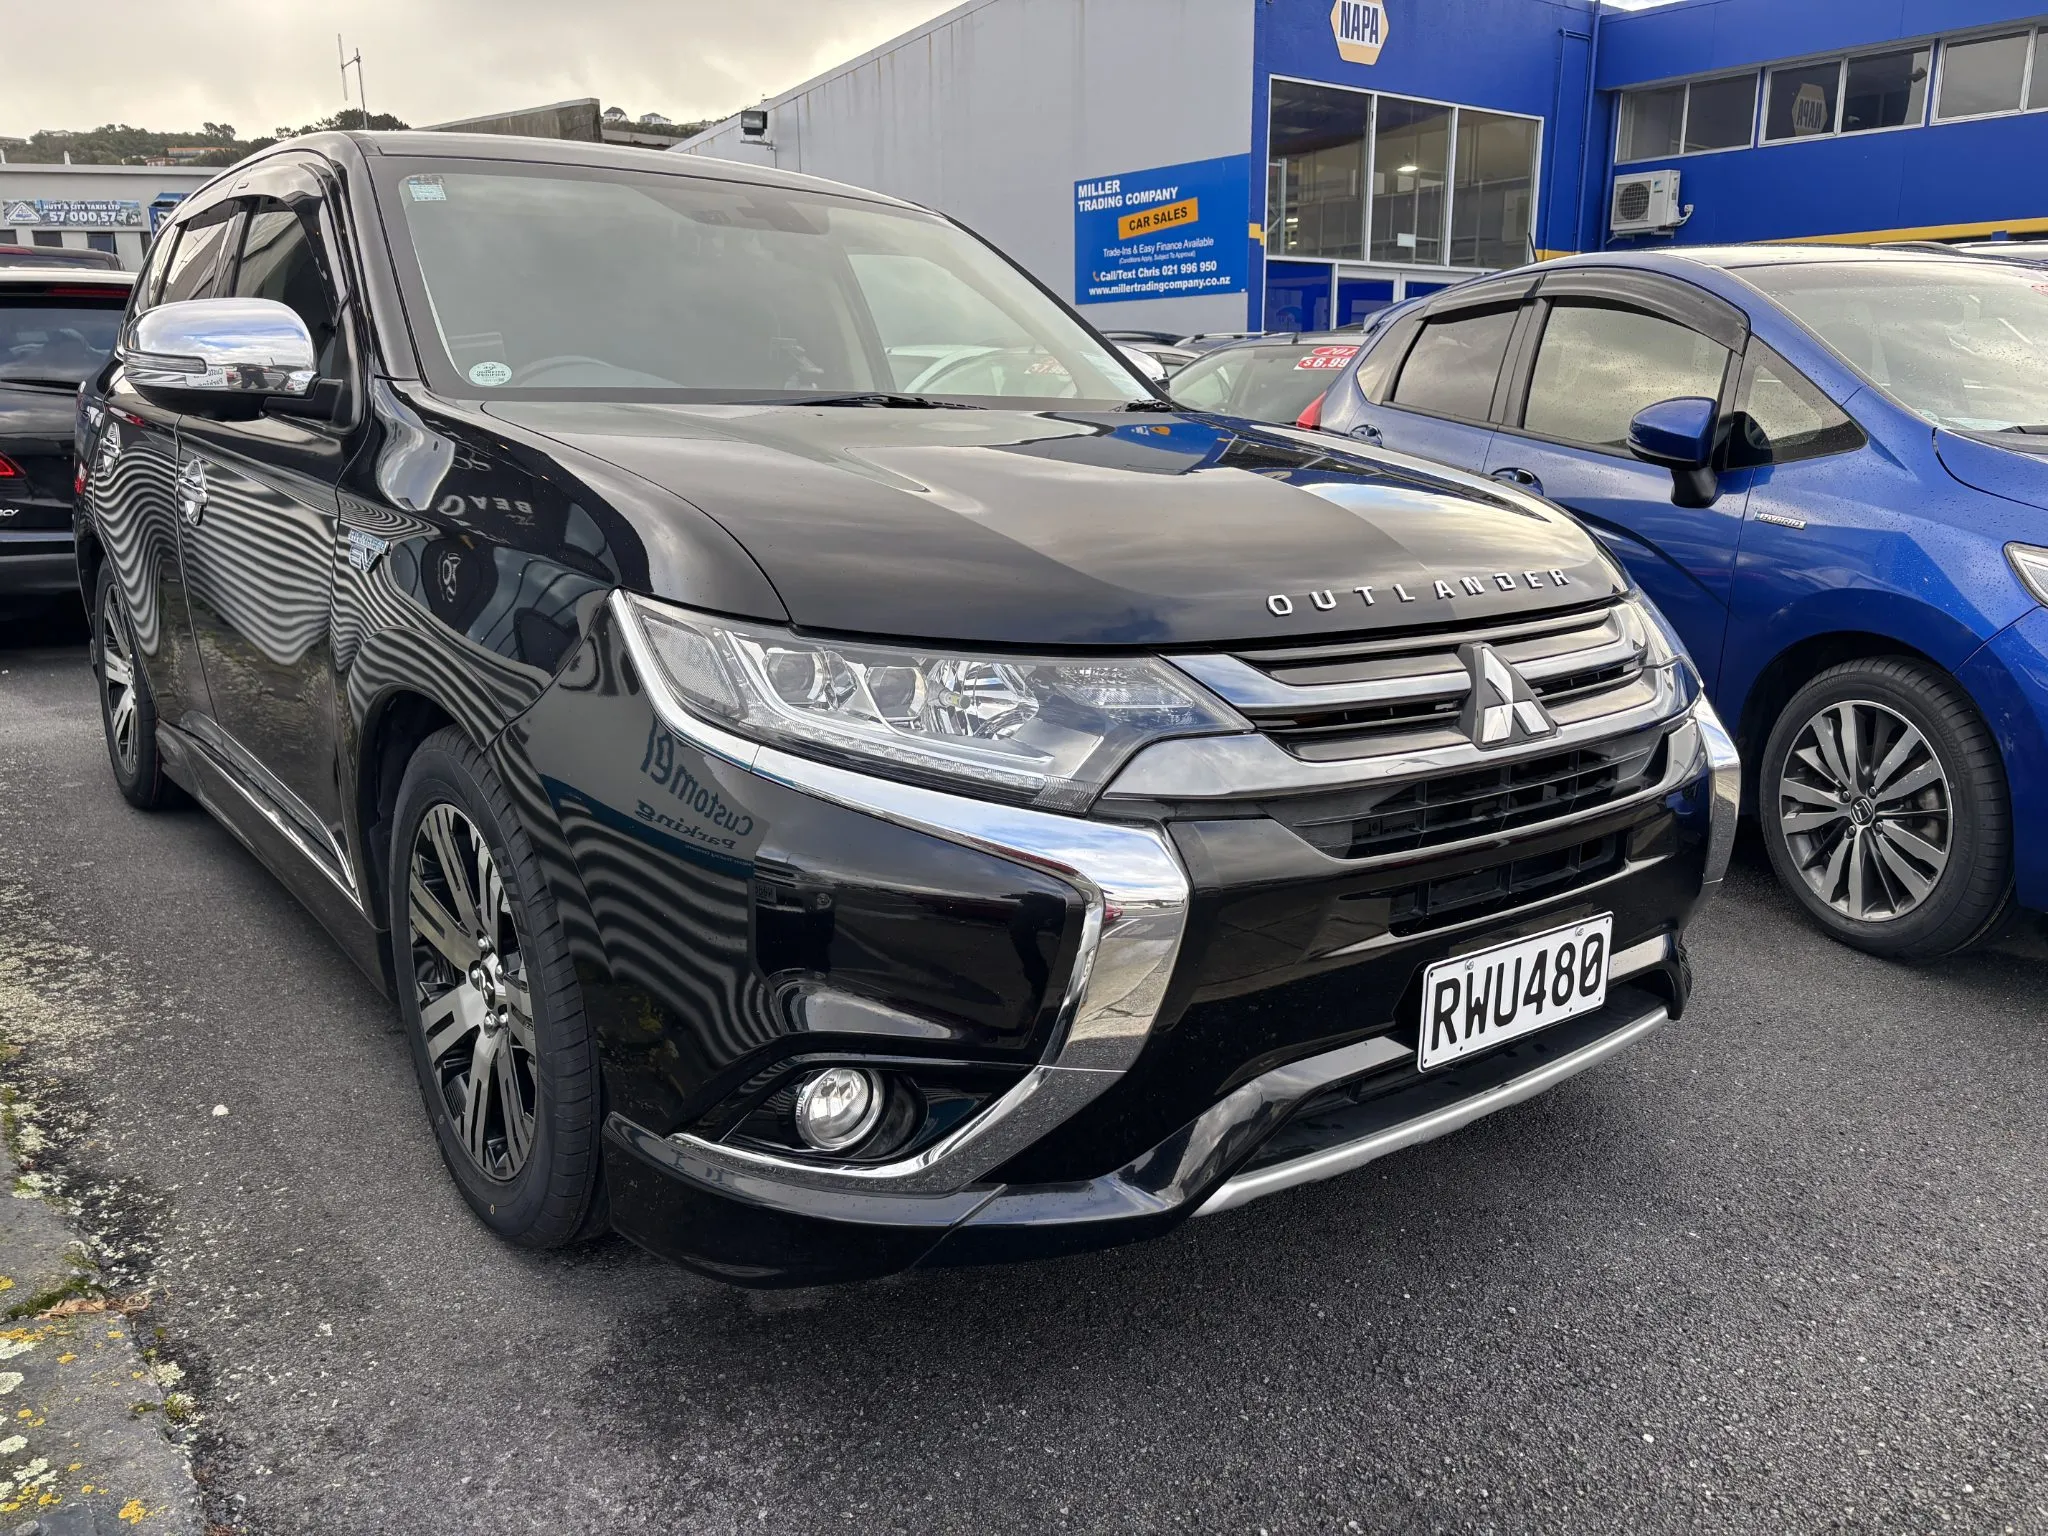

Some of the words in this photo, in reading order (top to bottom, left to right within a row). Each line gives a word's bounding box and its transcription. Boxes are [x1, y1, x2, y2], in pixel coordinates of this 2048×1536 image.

[1340, 1, 1379, 44] NAPA
[1078, 179, 1121, 198] MILLER
[1078, 196, 1123, 212] TRADING
[1125, 186, 1179, 205] COMPANY
[1129, 215, 1150, 231] CAR
[1153, 206, 1188, 226] SALES
[1103, 247, 1132, 258] Trade-Ins
[1132, 245, 1139, 254] &
[1139, 243, 1155, 254] Easy
[1156, 241, 1182, 252] Finance
[1183, 237, 1214, 249] Available
[1100, 268, 1136, 282] Call/Text
[1138, 266, 1160, 279] Chris
[1161, 263, 1178, 275] 021
[1180, 262, 1198, 274] 996
[1199, 260, 1217, 272] 950
[1089, 275, 1231, 296] www.millertradingcompany.co.nz
[1266, 568, 1571, 616] OUTLANDER
[1430, 932, 1604, 1051] RWU480
